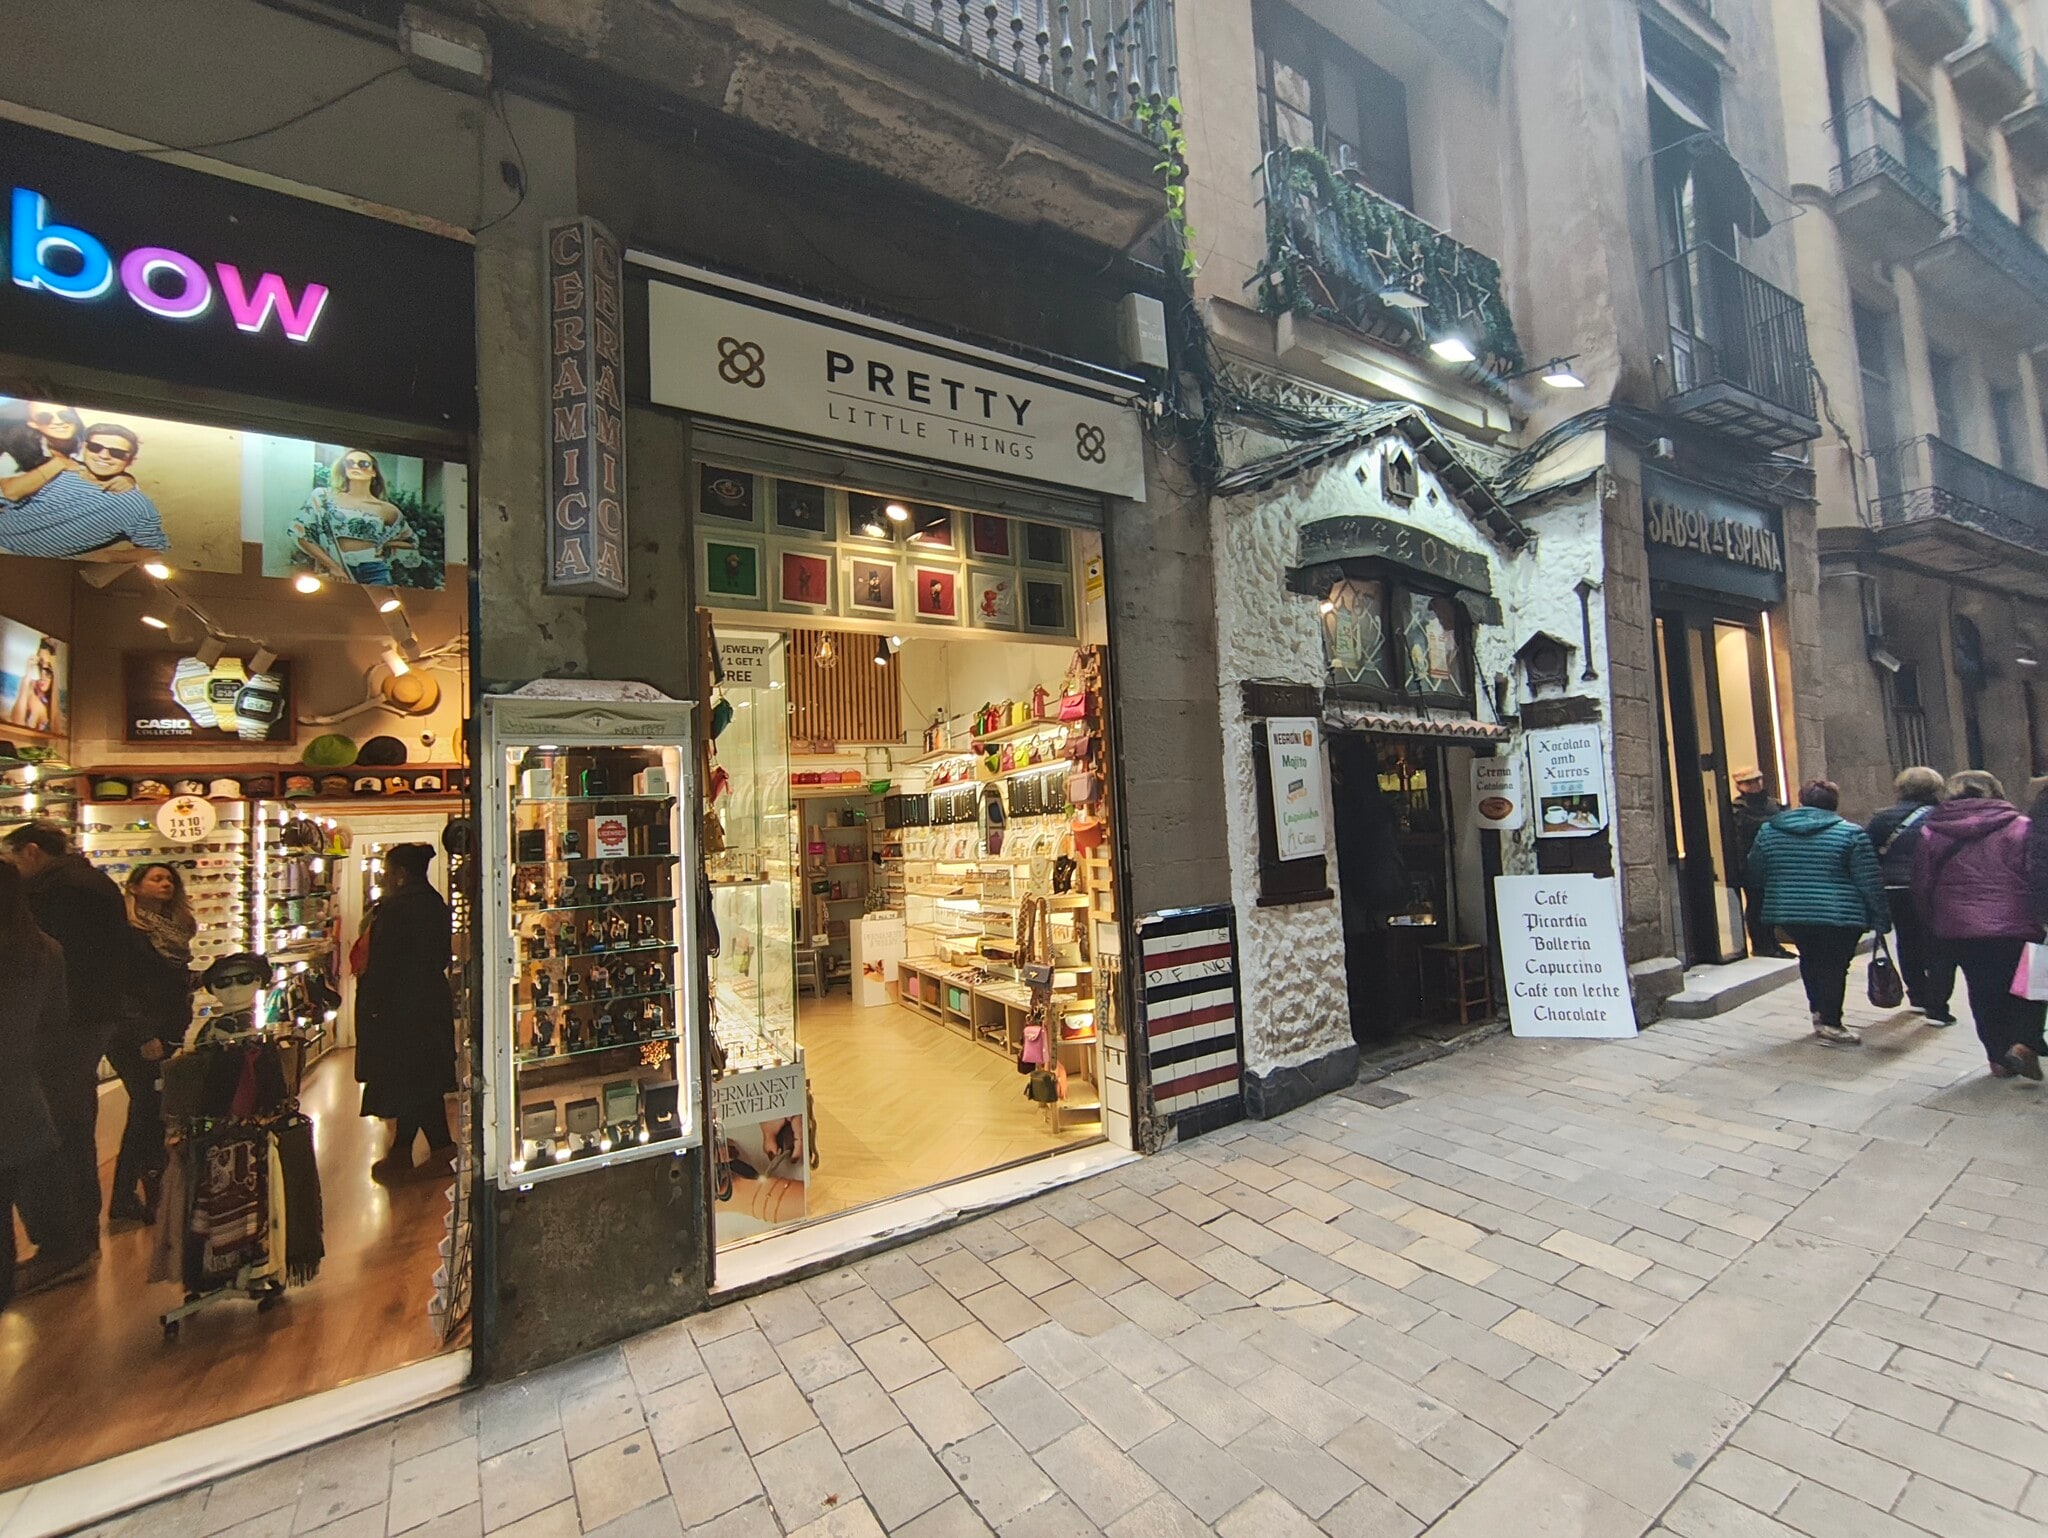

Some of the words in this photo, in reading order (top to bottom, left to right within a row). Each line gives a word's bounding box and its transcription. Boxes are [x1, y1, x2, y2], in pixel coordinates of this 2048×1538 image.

[12, 187, 329, 342] bow
[826, 350, 1032, 426] PRETTY
[551, 227, 591, 577] CERAMICA
[593, 238, 623, 583] CERAMICA
[829, 403, 926, 438] LITTLE
[948, 428, 1034, 460] THINGS
[1649, 500, 1712, 554] SABOR
[1725, 515, 1783, 573] ESPAÑA
[721, 644, 765, 655] JEWELRY
[735, 657, 753, 667] GET
[135, 718, 192, 729] CASIO
[1550, 752, 1576, 766] amb
[1543, 766, 1591, 780] Xurros
[170, 828, 177, 838] 2
[1534, 890, 1568, 905] Café
[1525, 958, 1603, 976] Capuccino
[1514, 981, 1548, 998] Café
[1554, 986, 1578, 998] con
[1582, 983, 1620, 998] leche
[1533, 1005, 1607, 1022] Chocolate
[721, 1092, 788, 1120] JEWELRY
